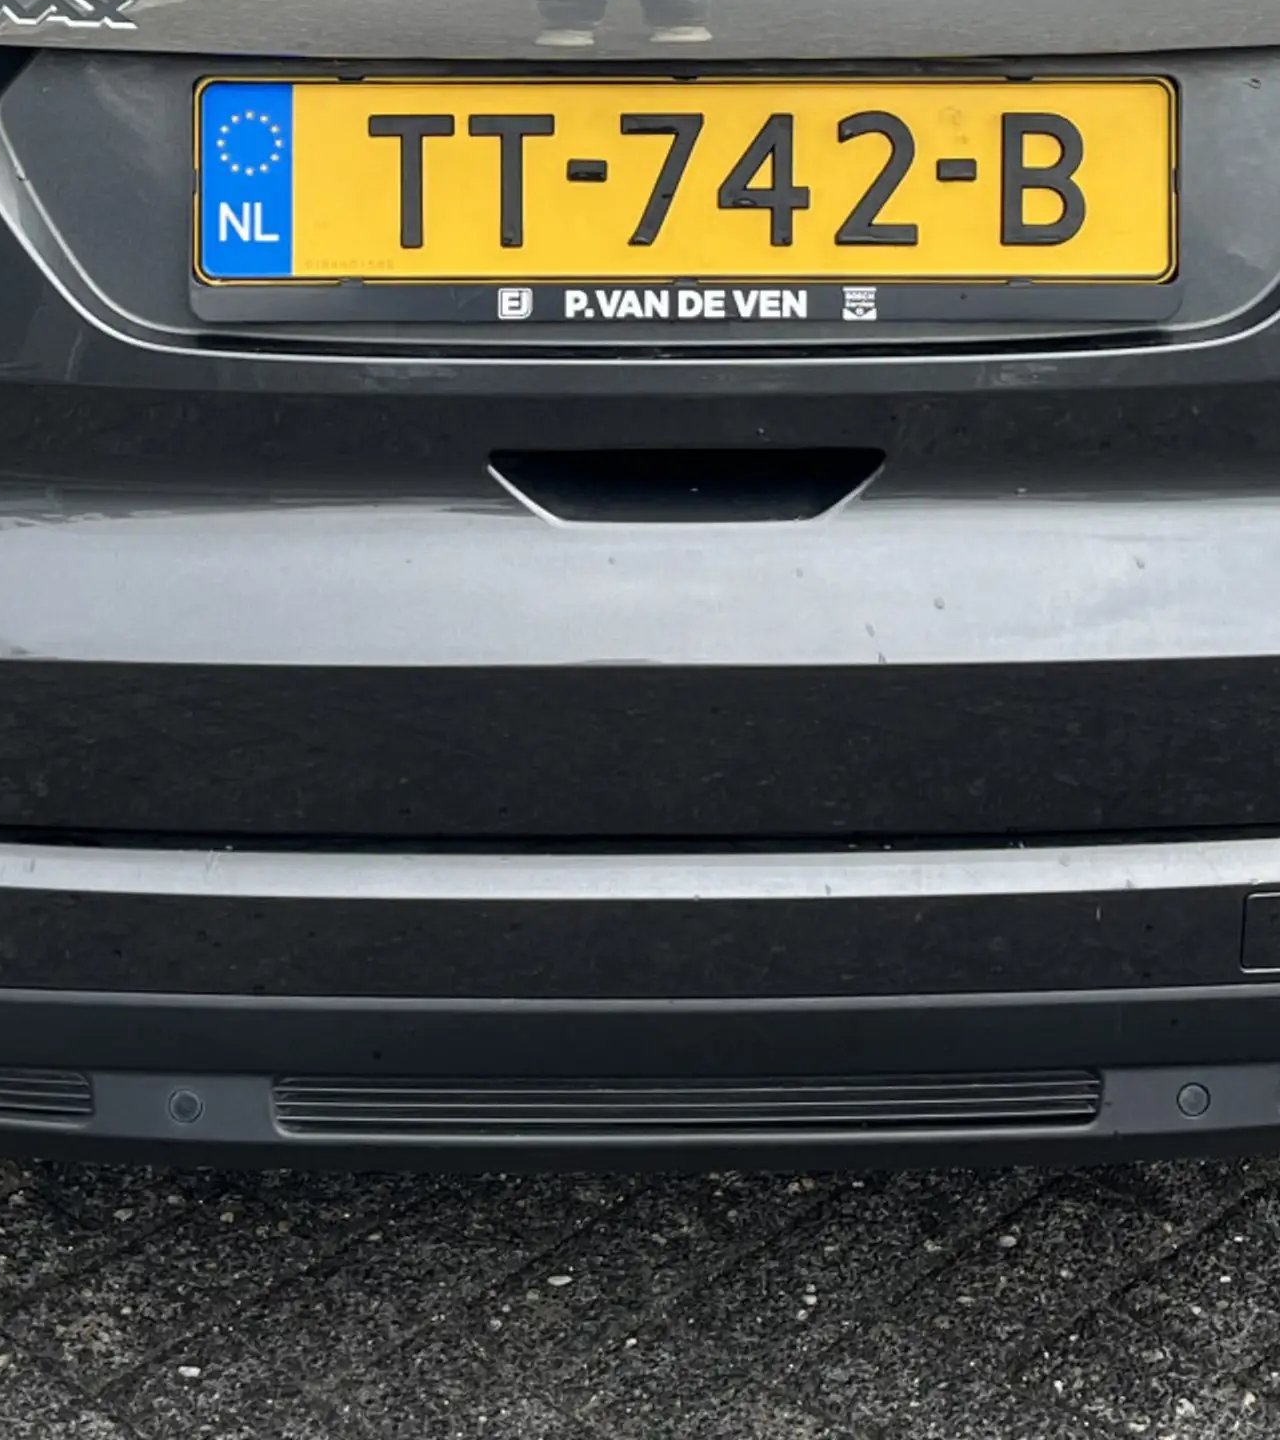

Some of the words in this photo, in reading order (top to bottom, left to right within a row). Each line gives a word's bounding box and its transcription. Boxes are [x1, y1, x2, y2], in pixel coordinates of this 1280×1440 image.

[368, 110, 1086, 248] TT-742-B
[220, 202, 279, 242] NL
[678, 289, 726, 318] DE
[732, 289, 808, 318] VEN
